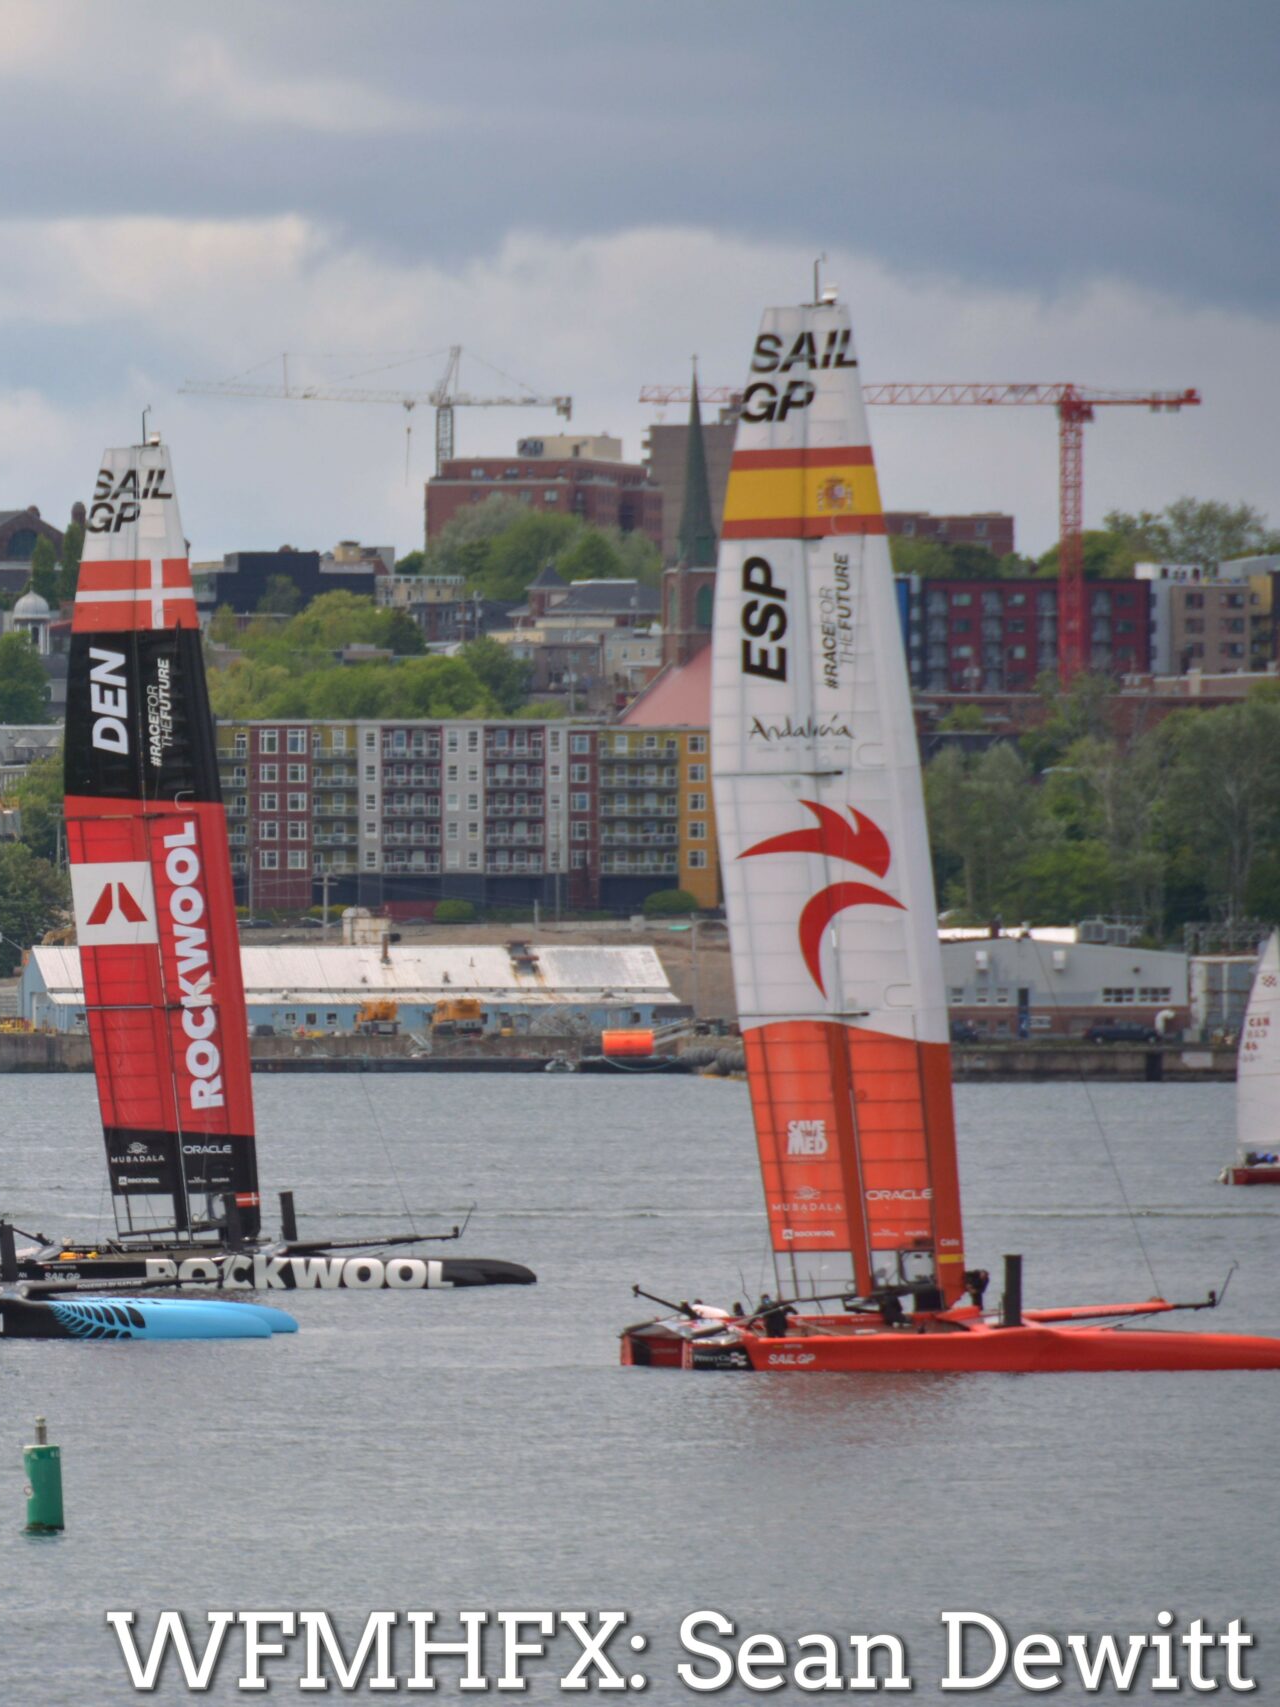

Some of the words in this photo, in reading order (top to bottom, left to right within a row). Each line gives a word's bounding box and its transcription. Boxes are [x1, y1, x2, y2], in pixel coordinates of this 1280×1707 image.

[750, 329, 858, 373] SAIL
[739, 380, 815, 423] GP
[94, 469, 173, 500] SAIL
[87, 502, 141, 533] GP
[742, 555, 787, 682] ESP
[89, 647, 129, 755] DEN
[163, 821, 225, 1109] ROCKWOOL
[110, 1154, 165, 1164] MUBADALA
[182, 1144, 233, 1154] ORACLE
[865, 1188, 933, 1201] ORACLE
[145, 1255, 454, 1290] ROCKWOOL
[768, 1353, 794, 1366] SAIL
[797, 1353, 817, 1365] GP
